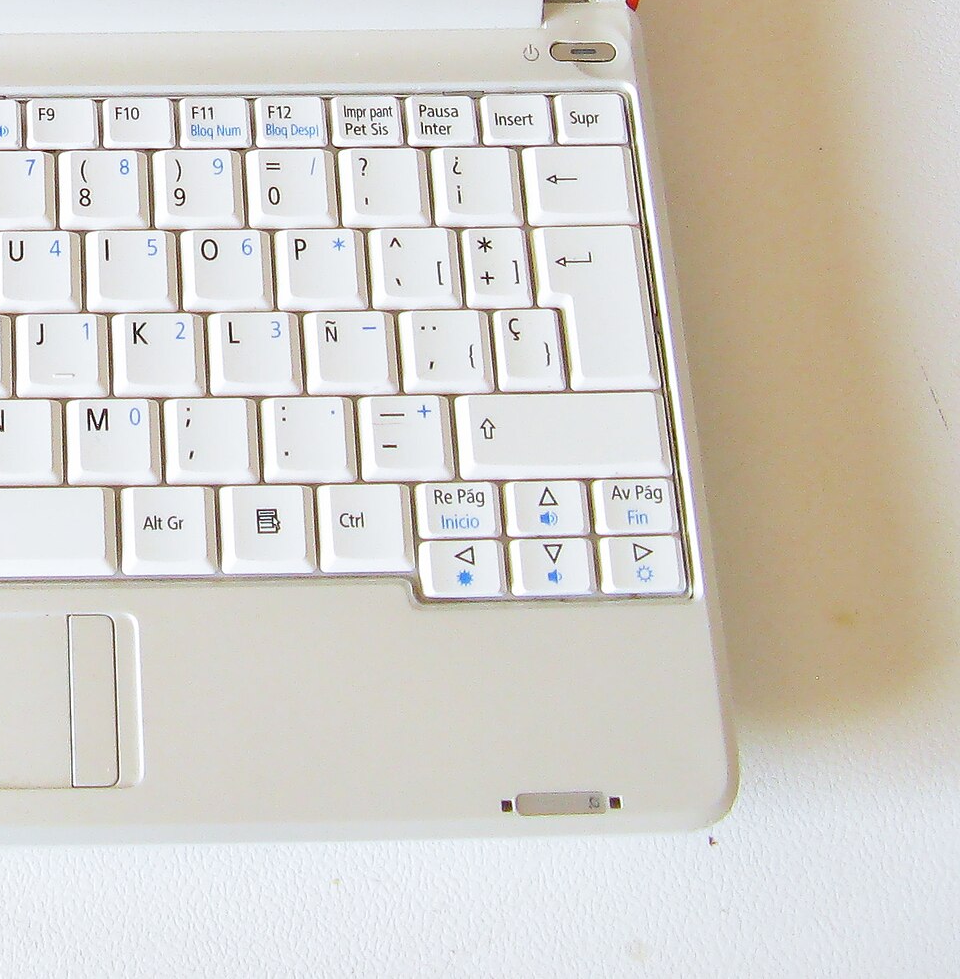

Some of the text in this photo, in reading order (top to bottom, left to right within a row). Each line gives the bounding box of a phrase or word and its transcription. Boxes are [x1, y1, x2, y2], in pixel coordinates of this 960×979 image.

[39, 108, 54, 121] F9
[115, 107, 139, 120] F10
[192, 107, 213, 119] F11
[268, 106, 291, 118] F12
[344, 105, 392, 121] Impr pant
[419, 104, 458, 117] Pausa
[495, 113, 533, 126] Insert
[570, 111, 599, 127] Supr
[191, 124, 241, 139] Bloq Num
[266, 123, 318, 138] Bloq Despl
[345, 120, 388, 135] Pet Sis
[421, 122, 451, 135] Inter
[26, 159, 35, 175] 7
[120, 159, 129, 175] 8
[213, 158, 223, 174] 9
[358, 157, 368, 177] ?
[79, 188, 91, 206] 8
[174, 188, 185, 206] 9
[268, 187, 280, 205] 0
[9, 240, 23, 262] U
[50, 240, 61, 256] 4
[104, 238, 110, 262] I
[148, 239, 157, 256] 5
[201, 239, 218, 261] O
[242, 239, 252, 255] 6
[295, 239, 306, 260] P
[35, 323, 44, 346] J
[82, 322, 89, 340] 1
[133, 322, 148, 344] K
[176, 322, 185, 339] 2
[229, 322, 240, 343] L
[271, 321, 281, 338] 3
[326, 321, 337, 342] Ñ
[509, 318, 520, 341] Ç
[87, 408, 108, 431] M
[130, 408, 140, 425] 0
[434, 489, 484, 507] Re Pág
[612, 485, 662, 503] Av Pág
[143, 516, 183, 530] Alt Gr
[340, 512, 364, 528] Ctrl
[442, 514, 479, 529] Inicio
[628, 510, 648, 524] Fin
